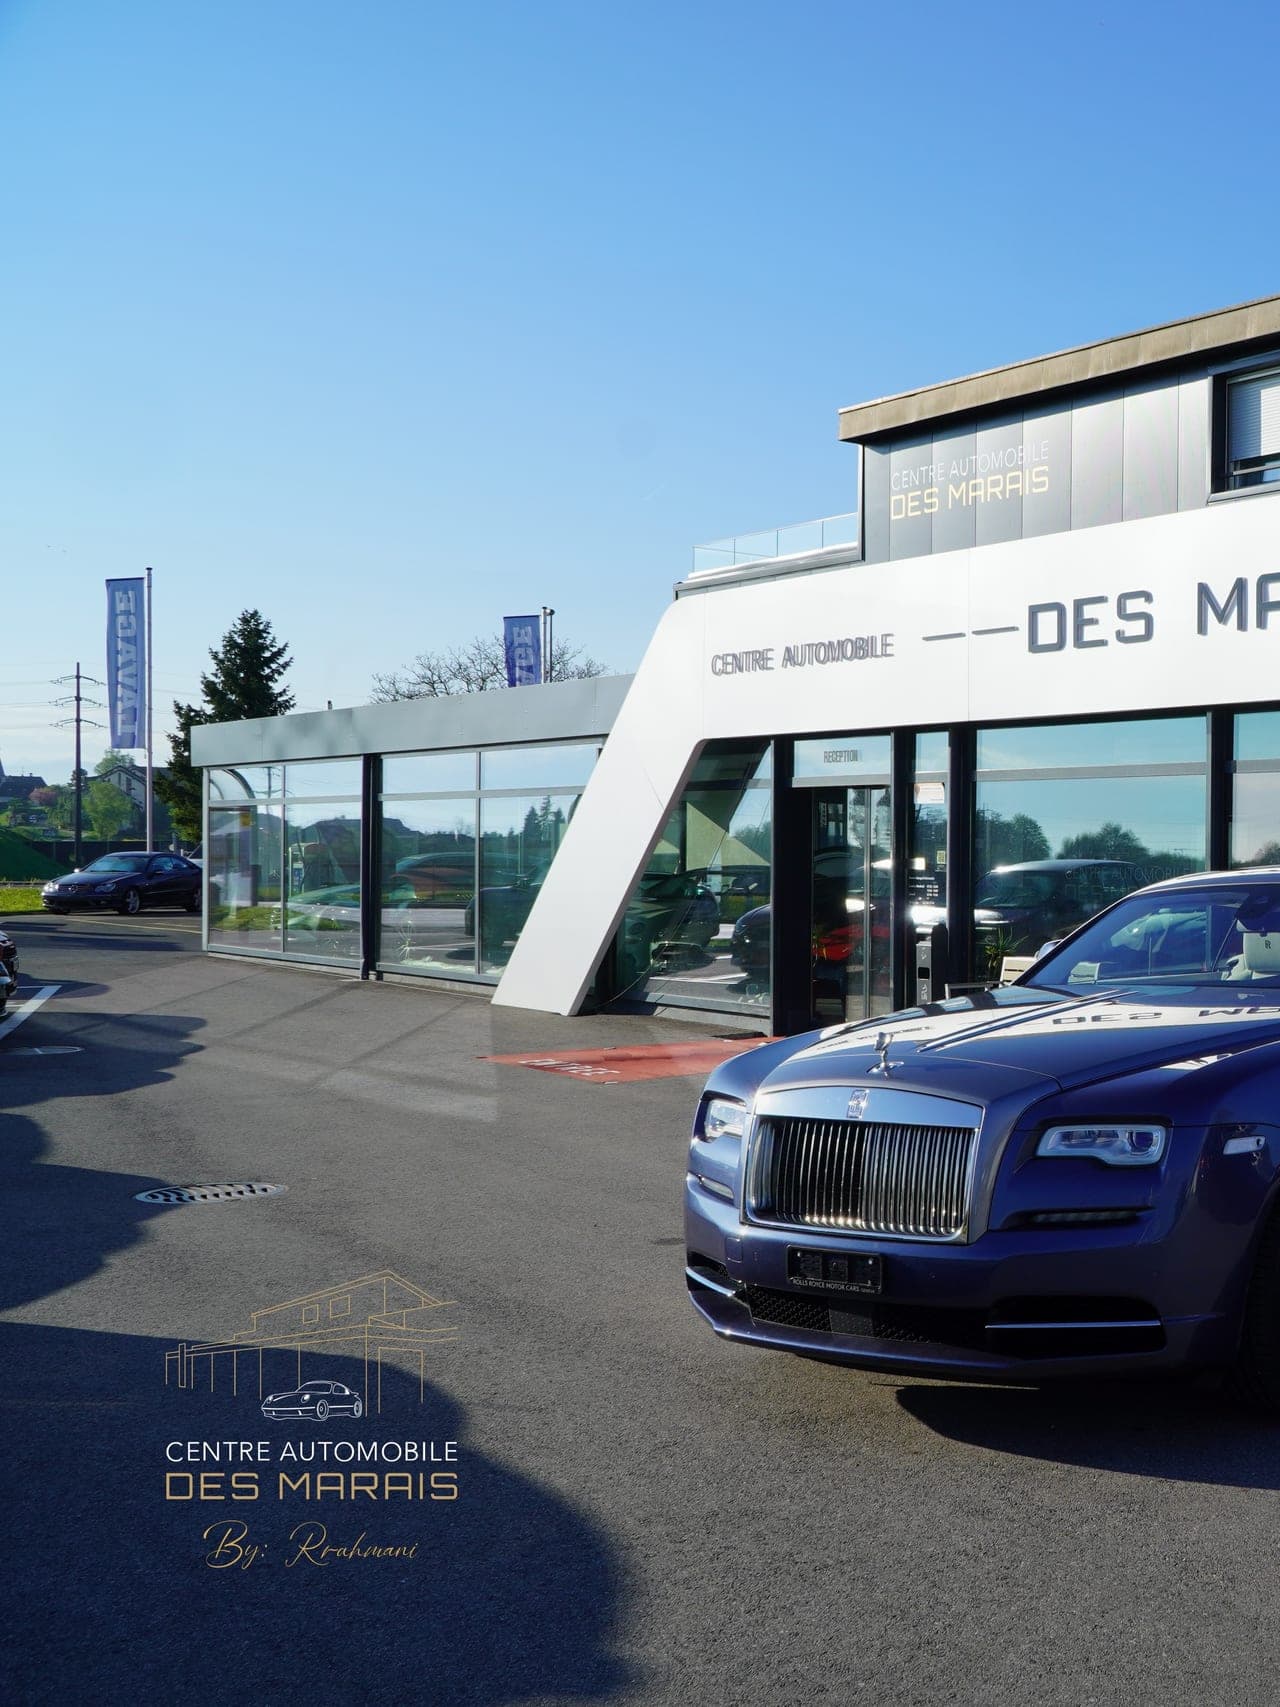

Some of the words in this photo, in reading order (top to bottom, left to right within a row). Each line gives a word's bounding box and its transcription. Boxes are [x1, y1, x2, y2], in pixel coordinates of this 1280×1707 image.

[891, 462, 945, 490] CENTRE
[950, 440, 1048, 477] AUTOMOBILE
[890, 487, 939, 520] DES
[948, 465, 1049, 510] MARAIS
[1027, 590, 1154, 654] DES
[711, 648, 775, 676] CENTRE
[782, 633, 894, 669] AUTOMOBILE
[823, 749, 859, 763] RECEPTION
